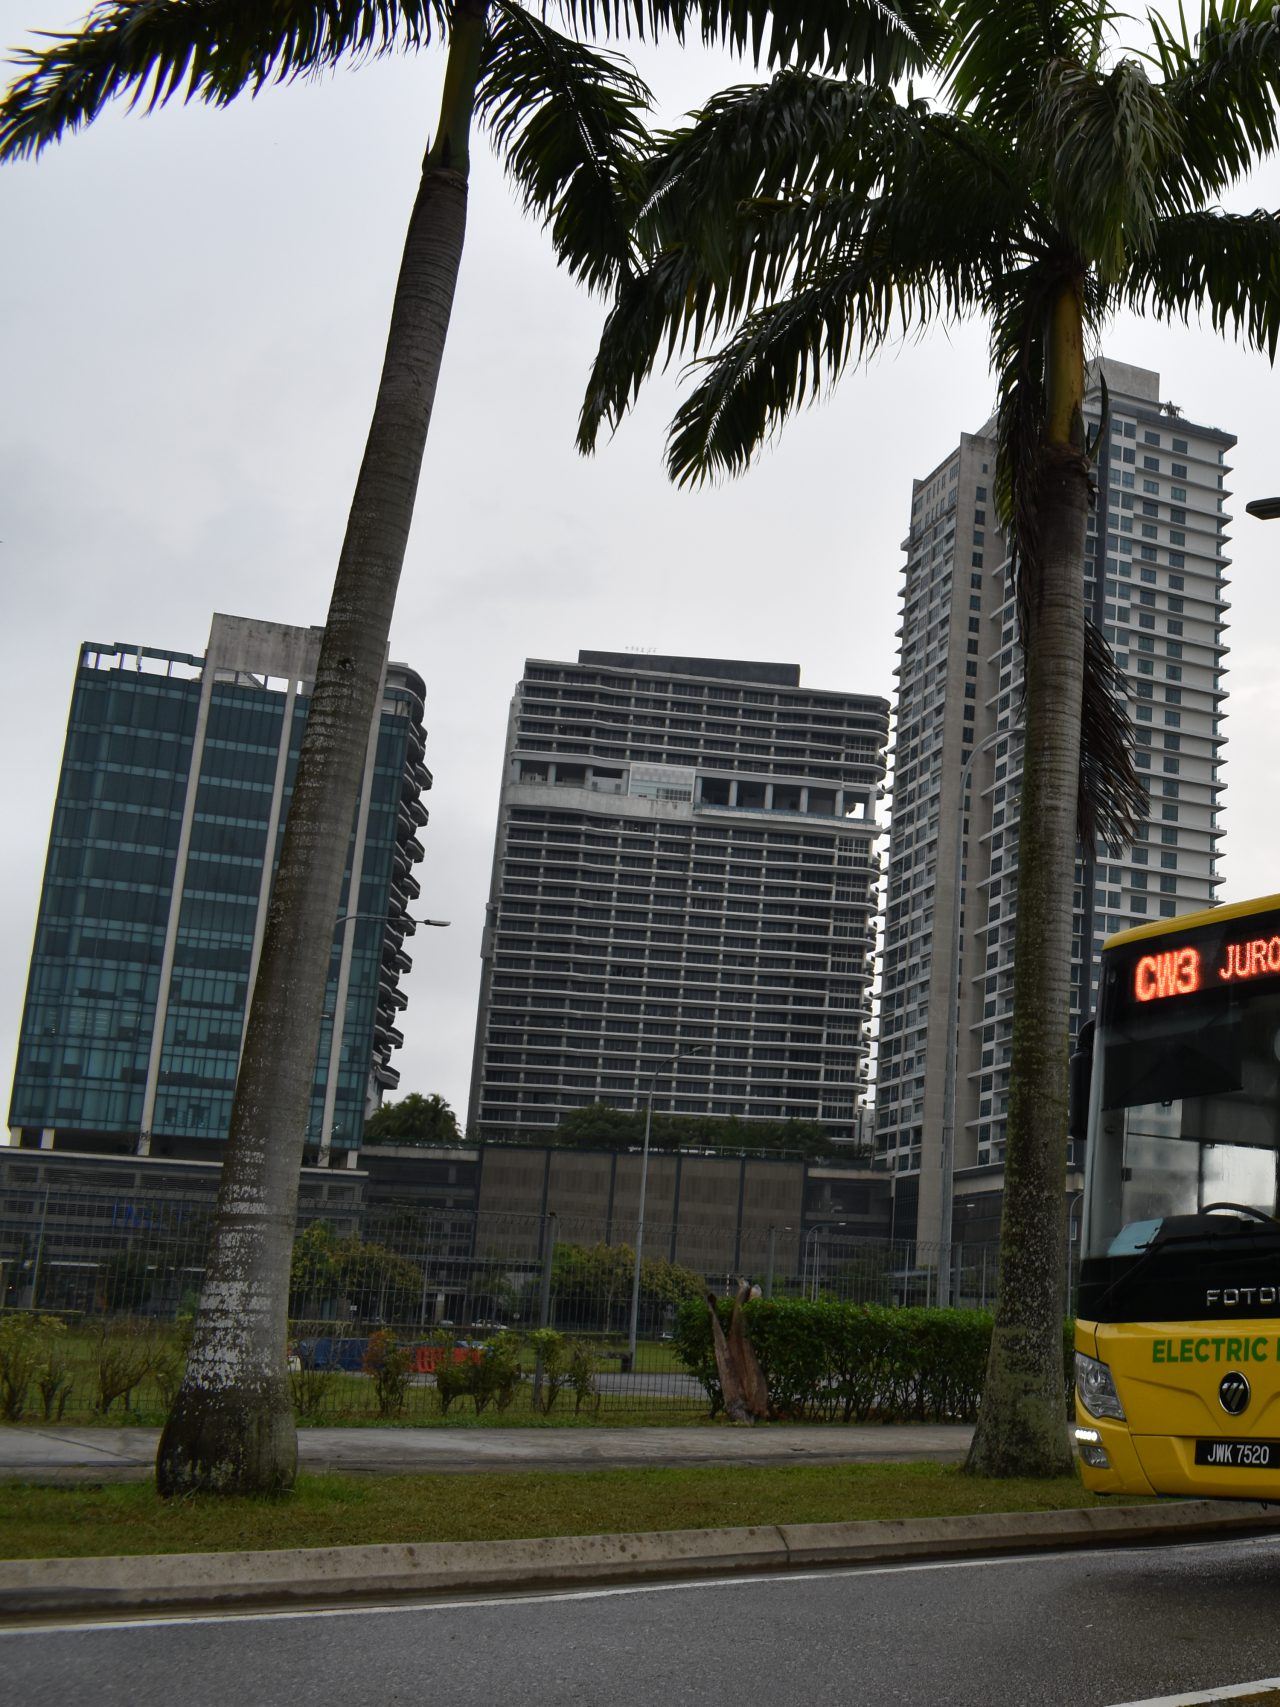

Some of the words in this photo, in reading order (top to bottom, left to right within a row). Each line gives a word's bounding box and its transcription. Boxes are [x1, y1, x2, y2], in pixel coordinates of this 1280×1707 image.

[1135, 947, 1200, 1002] CW3
[1152, 1337, 1269, 1363] ELECTRIC
[1207, 1443, 1233, 1464] JWK
[1236, 1444, 1270, 1465] 7520
